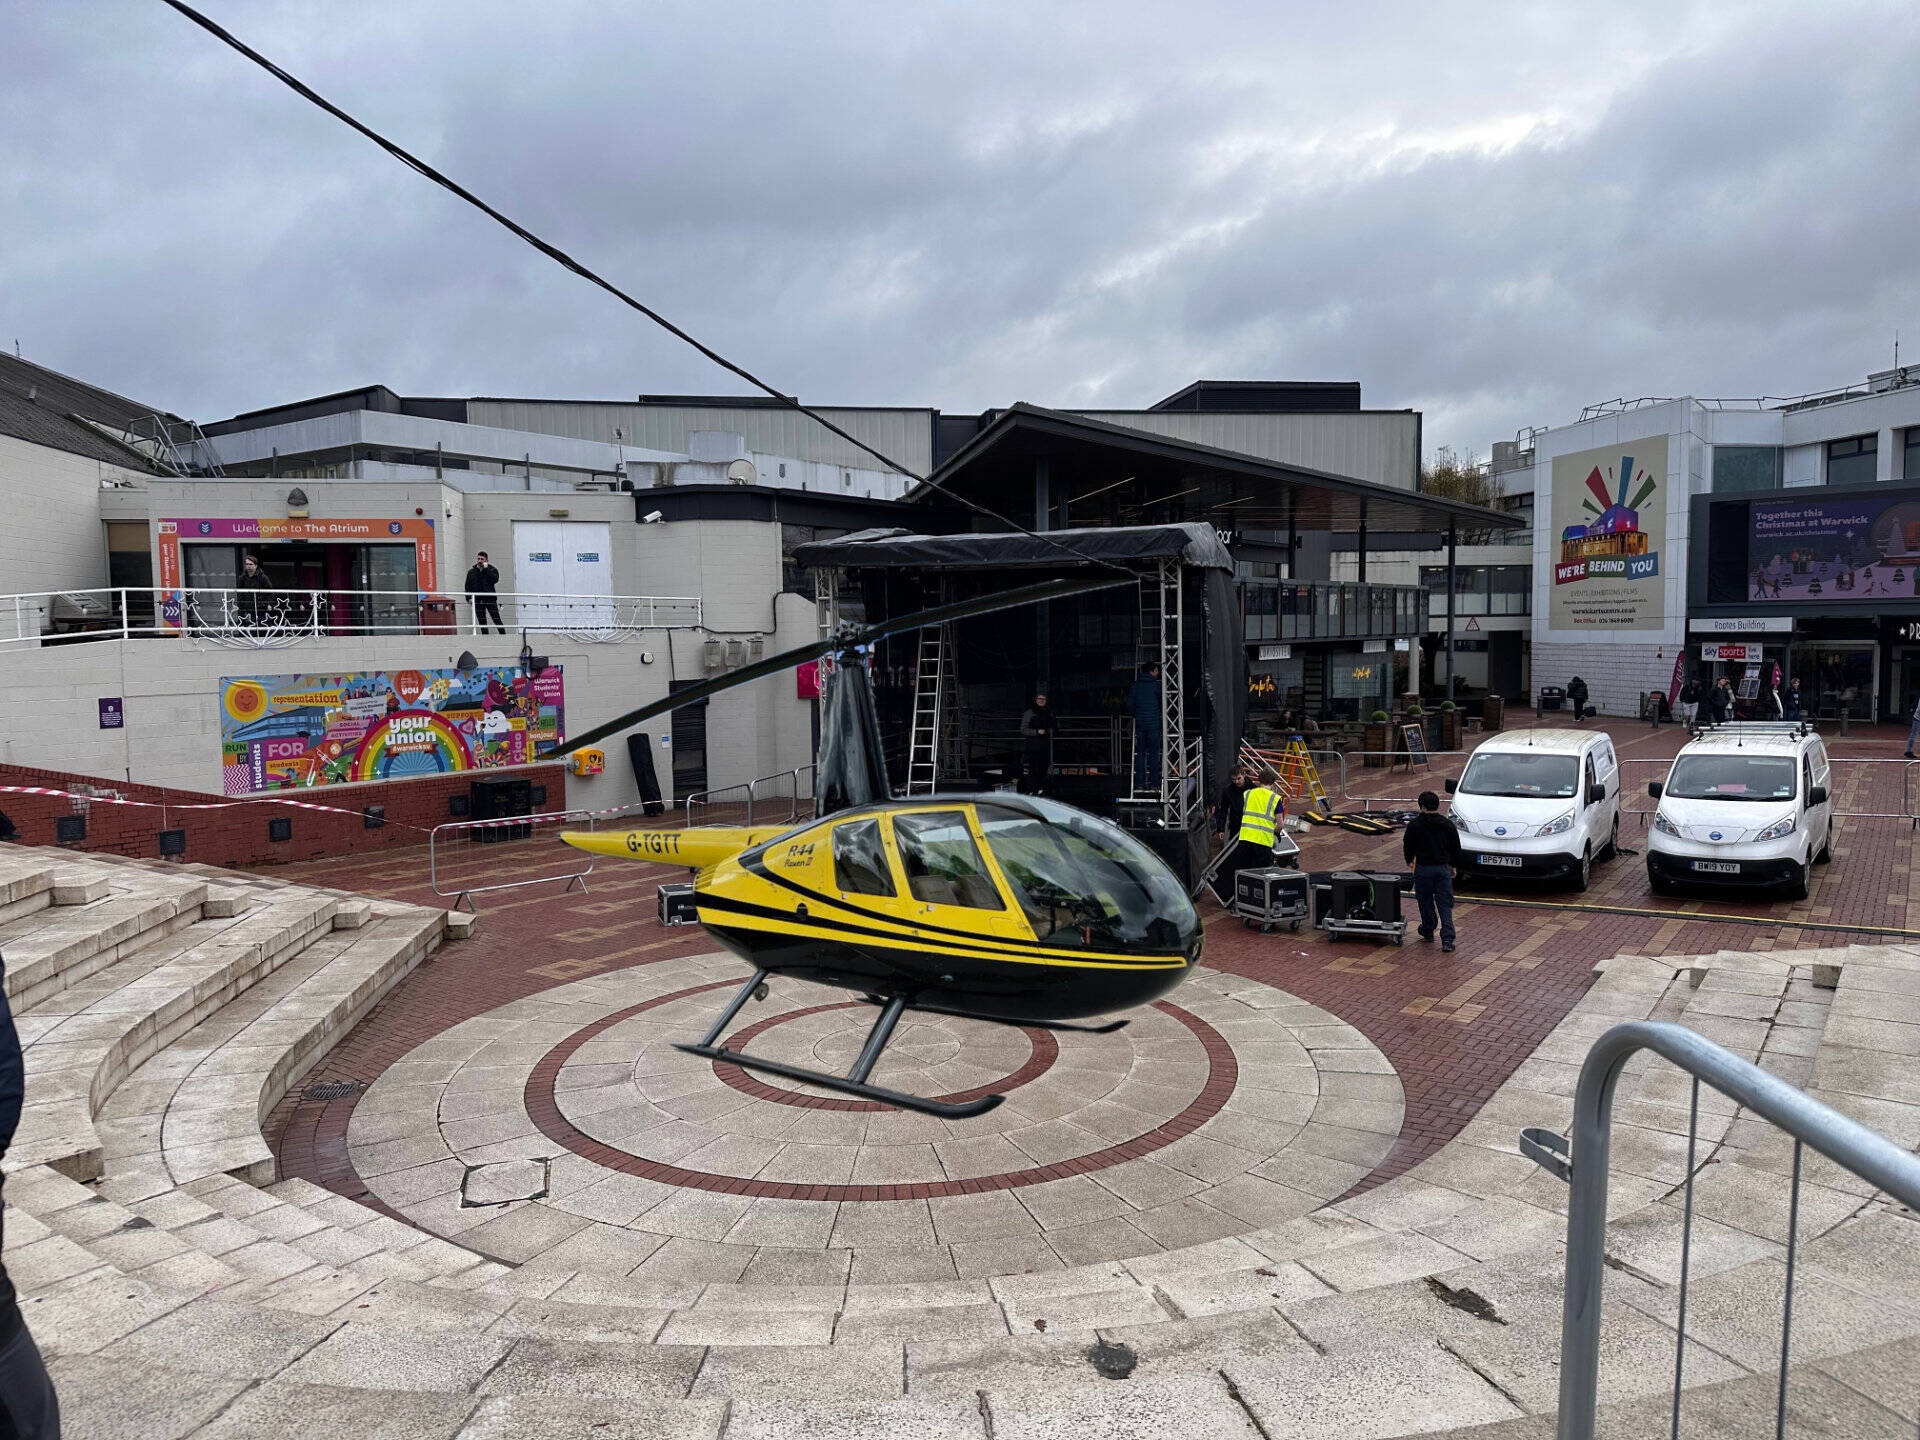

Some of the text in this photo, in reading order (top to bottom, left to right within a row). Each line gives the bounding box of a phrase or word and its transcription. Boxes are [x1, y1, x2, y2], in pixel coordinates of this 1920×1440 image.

[1755, 509, 1823, 521] Together this
[232, 523, 369, 533] Welcome to The Atrium
[1755, 519, 1806, 529] Christmas
[1820, 515, 1869, 526] Warwick
[1558, 559, 1654, 579] WE'RE BEHIND YOU
[1714, 620, 1766, 631] Rootes Building
[1704, 646, 1718, 658] sky
[1719, 647, 1745, 658] sports
[401, 686, 419, 695] you
[273, 692, 339, 705] representation
[389, 716, 432, 730] your
[385, 728, 436, 746] union
[529, 731, 553, 740] bonjour
[225, 743, 247, 752] RUN
[268, 742, 304, 757] FOR
[514, 732, 522, 762] Ciao
[253, 743, 263, 789] students
[269, 760, 299, 768] students
[626, 833, 681, 854] G-TGTT
[788, 843, 815, 856] R44
[784, 858, 805, 868] Raven
[1482, 855, 1503, 864] BP67
[1719, 863, 1736, 872] YOY
